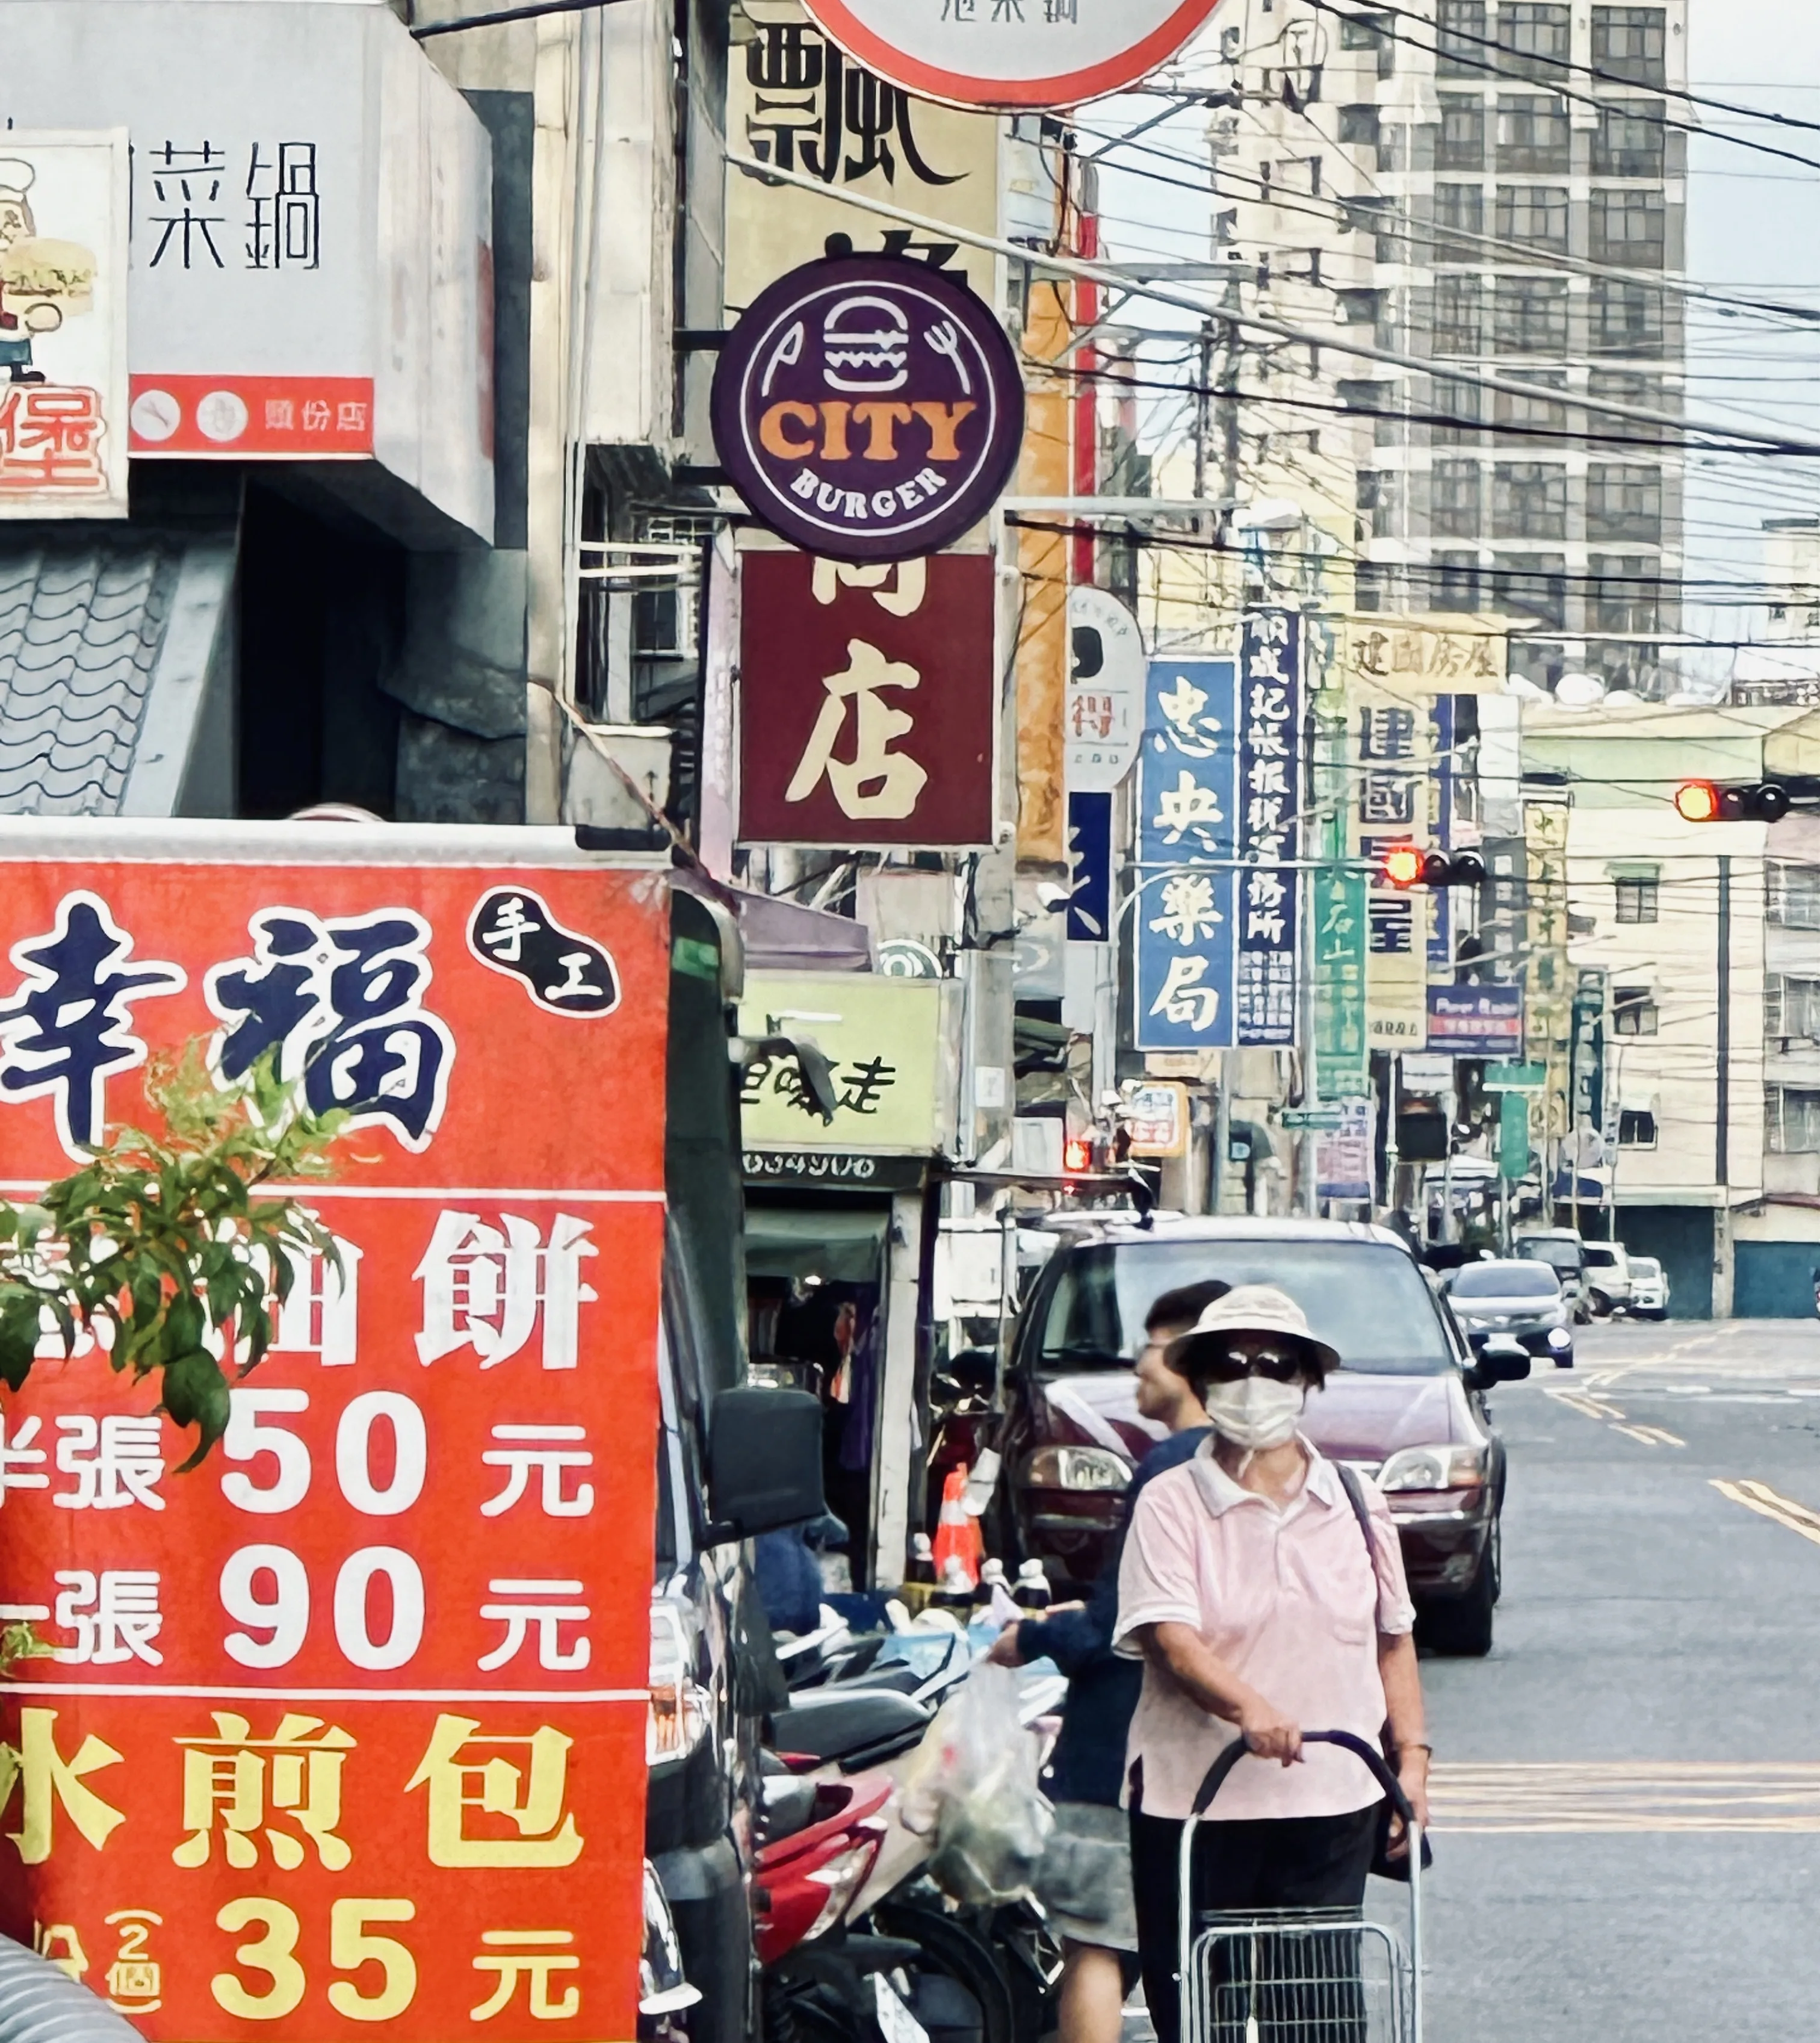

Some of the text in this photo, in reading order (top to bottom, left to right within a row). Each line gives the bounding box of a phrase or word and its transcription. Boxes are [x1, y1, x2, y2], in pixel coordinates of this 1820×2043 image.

[129, 140, 320, 269] 菜鍋
[0, 391, 99, 487] 堡
[759, 400, 976, 460] CITY
[789, 467, 948, 520] BURGER
[1149, 675, 1224, 1032] 忠央藥局
[483, 897, 604, 998] 手工
[0, 891, 455, 1152] 幸福
[221, 1387, 427, 1516] 50
[480, 1424, 595, 1518] 元
[220, 1544, 425, 1670] 90
[477, 1579, 591, 1672] 元
[0, 1707, 584, 1871] 水煎包
[211, 1897, 417, 2021] 35
[470, 1929, 580, 2022] 元
